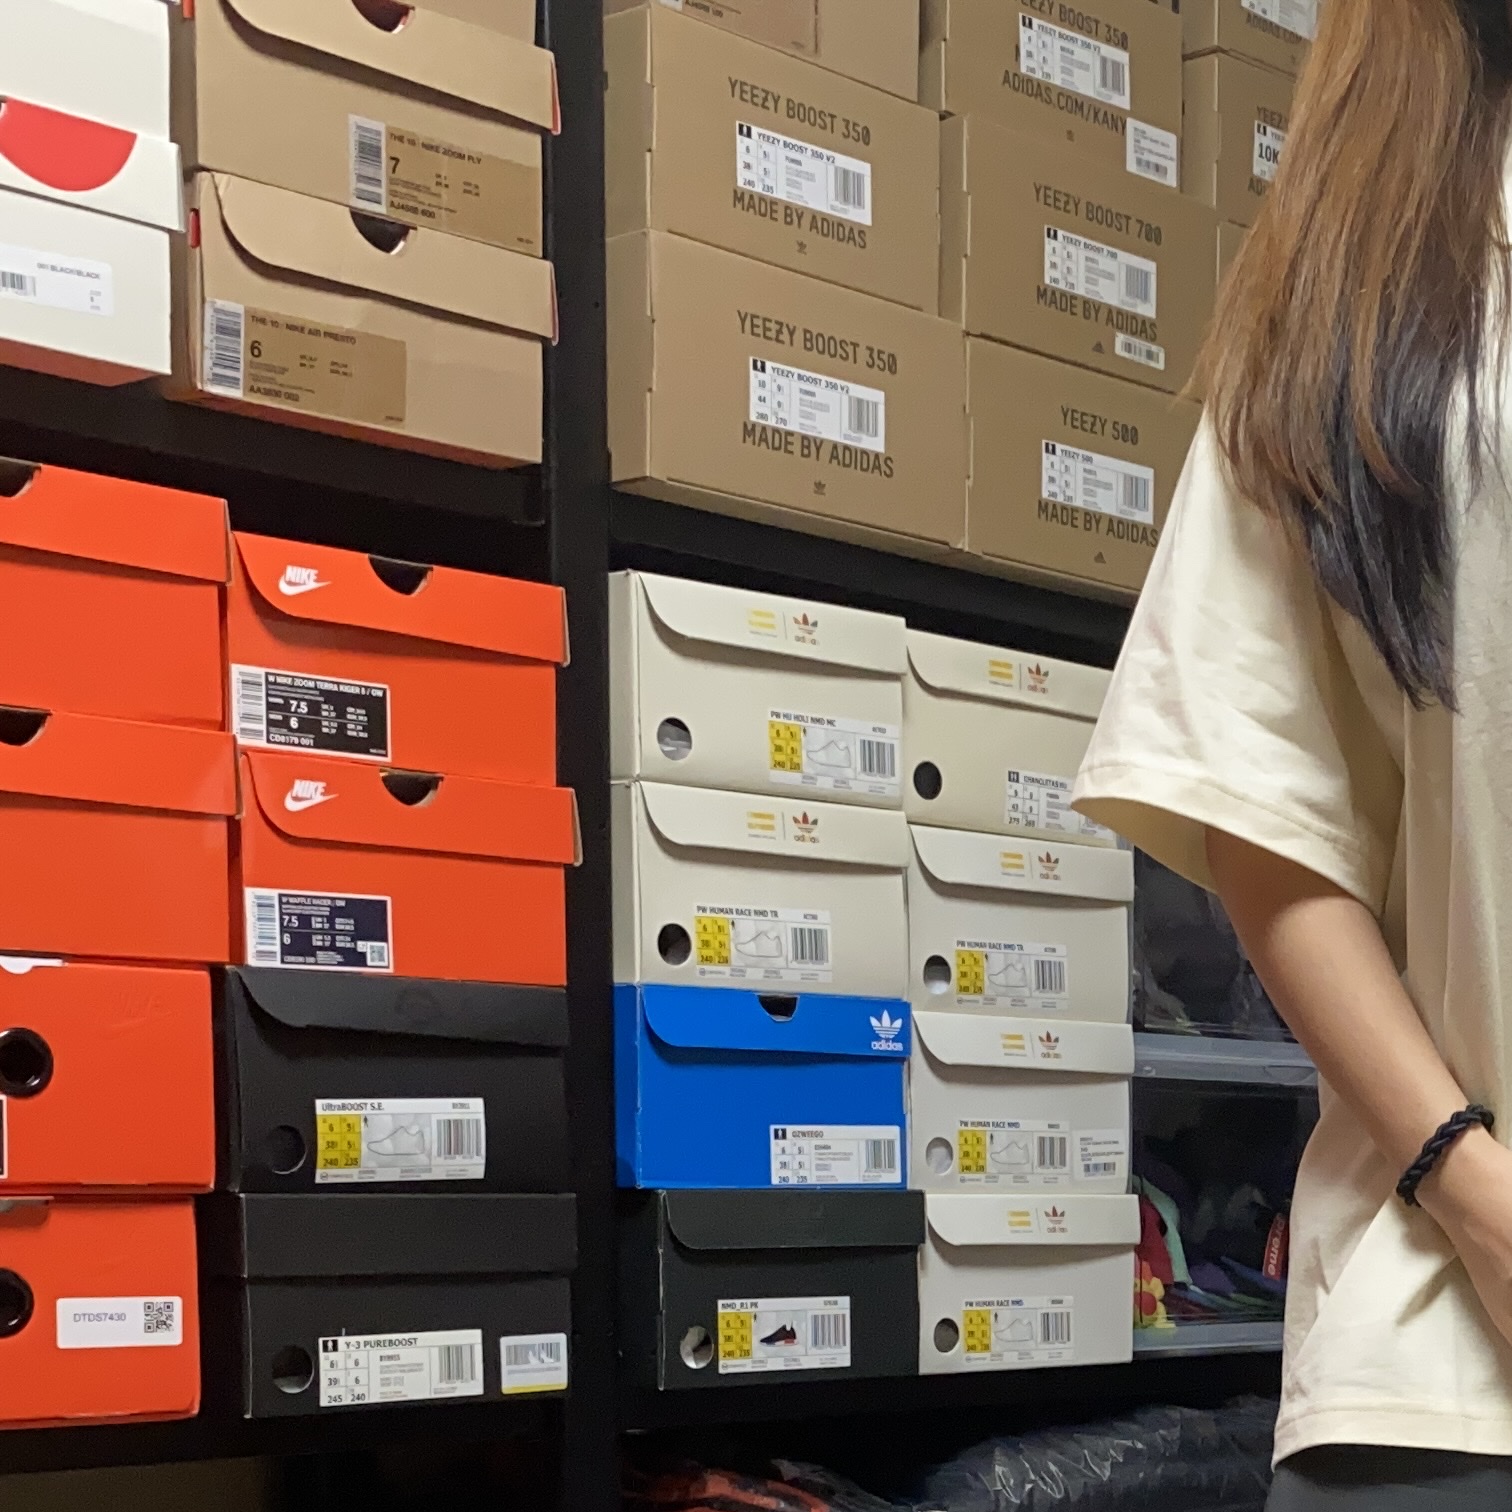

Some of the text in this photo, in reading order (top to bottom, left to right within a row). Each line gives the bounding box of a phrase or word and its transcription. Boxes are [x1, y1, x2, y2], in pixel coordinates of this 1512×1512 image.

[1059, 4, 1128, 50] BOOST 350
[728, 76, 871, 146] YEEZY BOOST 350
[757, 132, 780, 146] YEEZY
[784, 141, 808, 154] BOOST
[390, 156, 400, 174] 7
[733, 188, 867, 250] MADE BY ADIDAS
[1033, 182, 1162, 246] YEEZY BOOST 700
[1036, 285, 1158, 342] MADE BY ADIDAS
[252, 315, 267, 326] THE
[250, 340, 262, 358] 6
[737, 310, 898, 376] YEEZY BOOST 350
[771, 366, 794, 378] YEEZY
[798, 374, 822, 386] BOOST
[1060, 404, 1139, 446] YEEZY 500
[742, 421, 894, 478] MADE BY ADIDAS
[1037, 500, 1158, 548] MADE BY ADIDAS
[286, 564, 318, 584] NIKE
[294, 678, 314, 688] ZOOM
[289, 700, 308, 714] 7.5
[289, 716, 298, 729] 6
[292, 780, 328, 800] NIKE
[710, 906, 734, 915] HUMAN
[735, 908, 752, 916] RACE
[754, 910, 768, 918] NMD
[770, 910, 778, 918] TR
[282, 916, 299, 928] 7.5
[283, 934, 291, 946] 6
[871, 1040, 904, 1052] adidas
[322, 1102, 384, 1112] UltraBOOST S.E.
[328, 1123, 334, 1132] 6
[970, 1120, 990, 1128] HUMAN
[792, 1130, 824, 1138] OZWEEGO
[722, 1302, 748, 1311] NMD_R1
[74, 1313, 126, 1322] DTDS7430
[344, 1338, 418, 1350] Y-3 PUREBOOST
[354, 1358, 360, 1366] 6
[354, 1376, 360, 1384] 6
[327, 1394, 342, 1404] 245
[350, 1394, 366, 1402] 240
